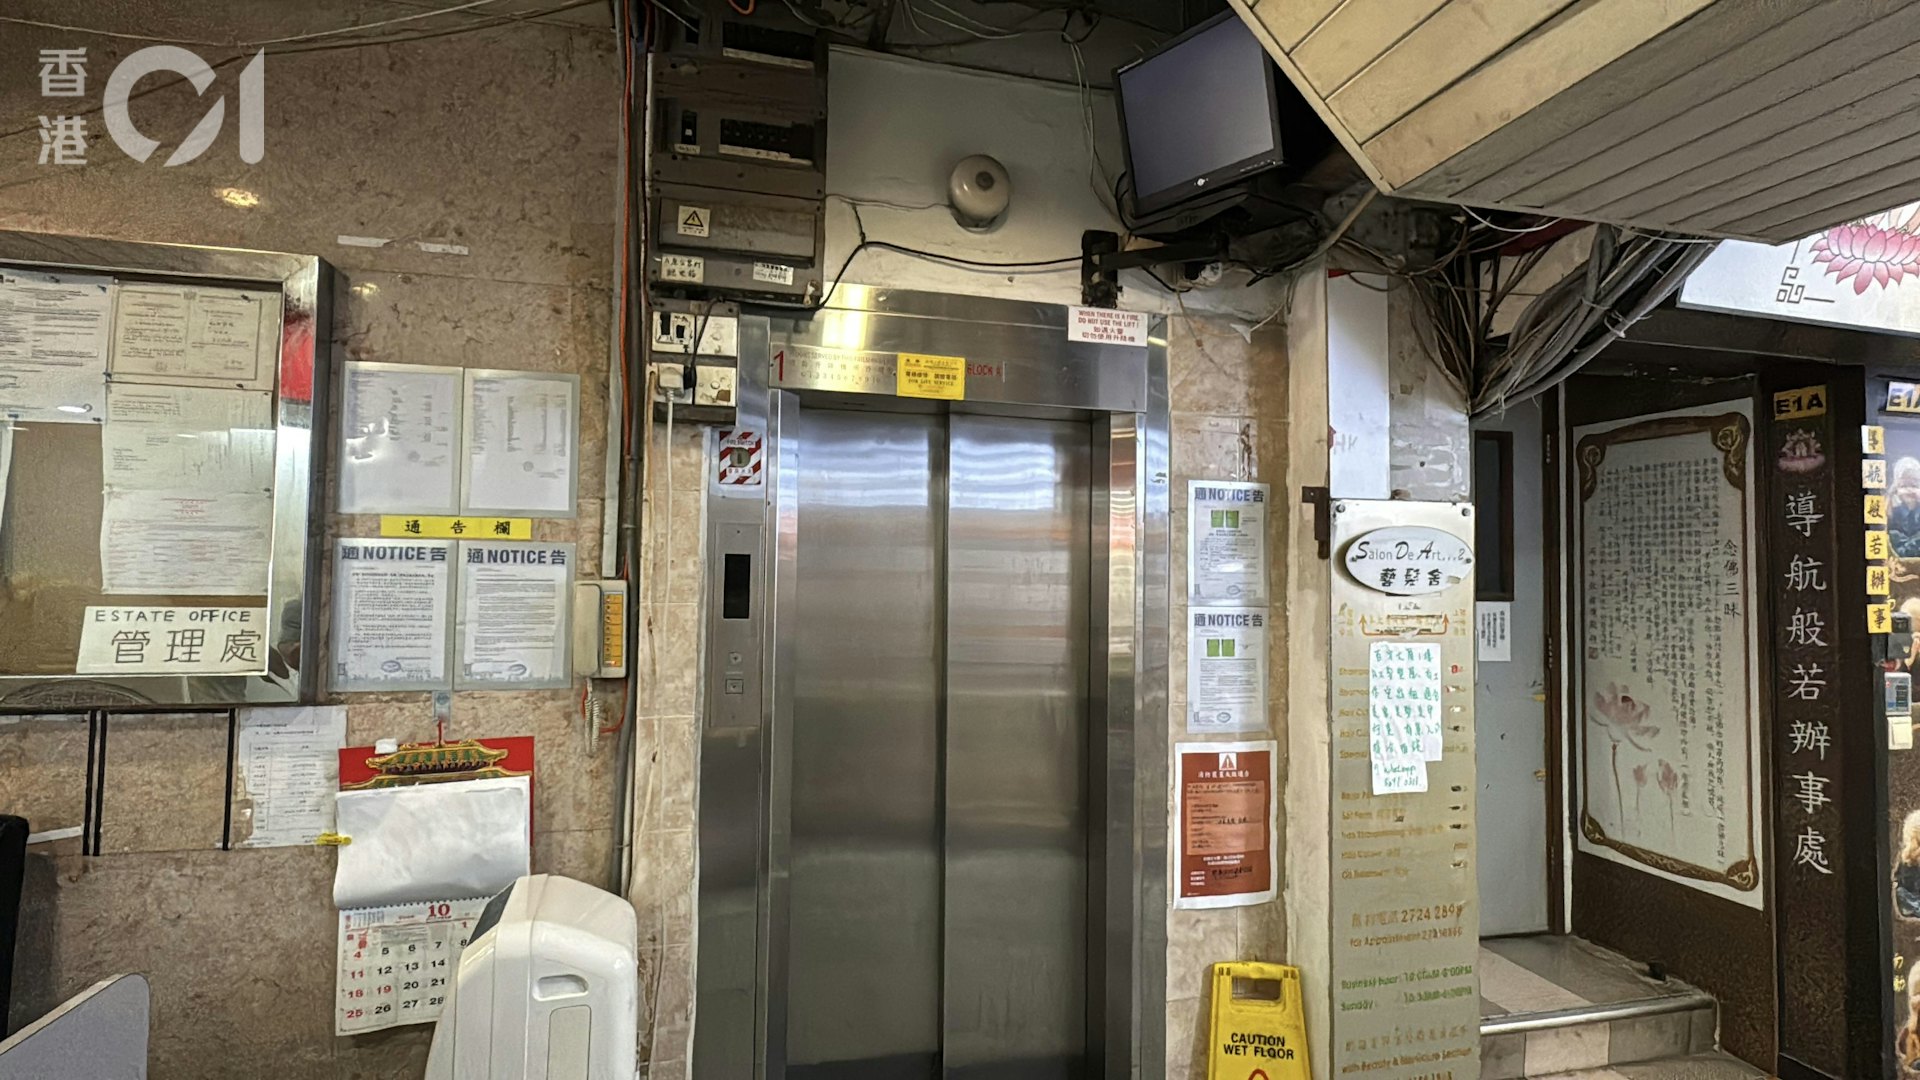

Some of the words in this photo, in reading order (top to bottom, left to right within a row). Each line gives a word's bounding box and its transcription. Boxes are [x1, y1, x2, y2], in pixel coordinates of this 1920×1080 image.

[1096, 311, 1114, 319] THERE
[1082, 332, 1136, 342] 切勿使用升降機
[1094, 326, 1124, 334] 如遇火警
[773, 350, 784, 382] 1
[1775, 392, 1824, 415] E1A
[1208, 488, 1250, 502] NOTICE
[1253, 490, 1264, 502] 告
[404, 519, 511, 535] 通告欄
[363, 546, 426, 560] NOTICE
[429, 547, 448, 561] 告
[467, 548, 484, 564] 通
[488, 549, 547, 564] NOTICE
[550, 549, 566, 565] 告
[1354, 541, 1393, 561] Salon
[1395, 541, 1415, 560] De
[95, 610, 176, 622] ESTATE
[188, 610, 251, 623] OFFICE
[1208, 614, 1250, 626] NOTICE
[1252, 614, 1263, 627] 告
[110, 628, 262, 664] 管理處
[1783, 491, 1834, 875] 導航般若辦事處
[428, 904, 450, 918] 10
[1401, 908, 1432, 924] 2724
[354, 951, 362, 959] 4
[350, 971, 364, 980] 11
[377, 966, 392, 975] 12
[404, 962, 419, 971] 13
[431, 959, 446, 968] 14
[348, 990, 364, 1000] 18
[376, 986, 392, 994] 19
[404, 981, 419, 990] 20
[430, 978, 446, 986] 21
[346, 1010, 363, 1019] 25
[374, 1005, 392, 1014] 26
[402, 1000, 418, 1009] 27
[429, 996, 444, 1006] 28
[1230, 1032, 1286, 1047] CAUTION
[1224, 1044, 1248, 1056] WET
[1254, 1046, 1294, 1060] FLOOR
